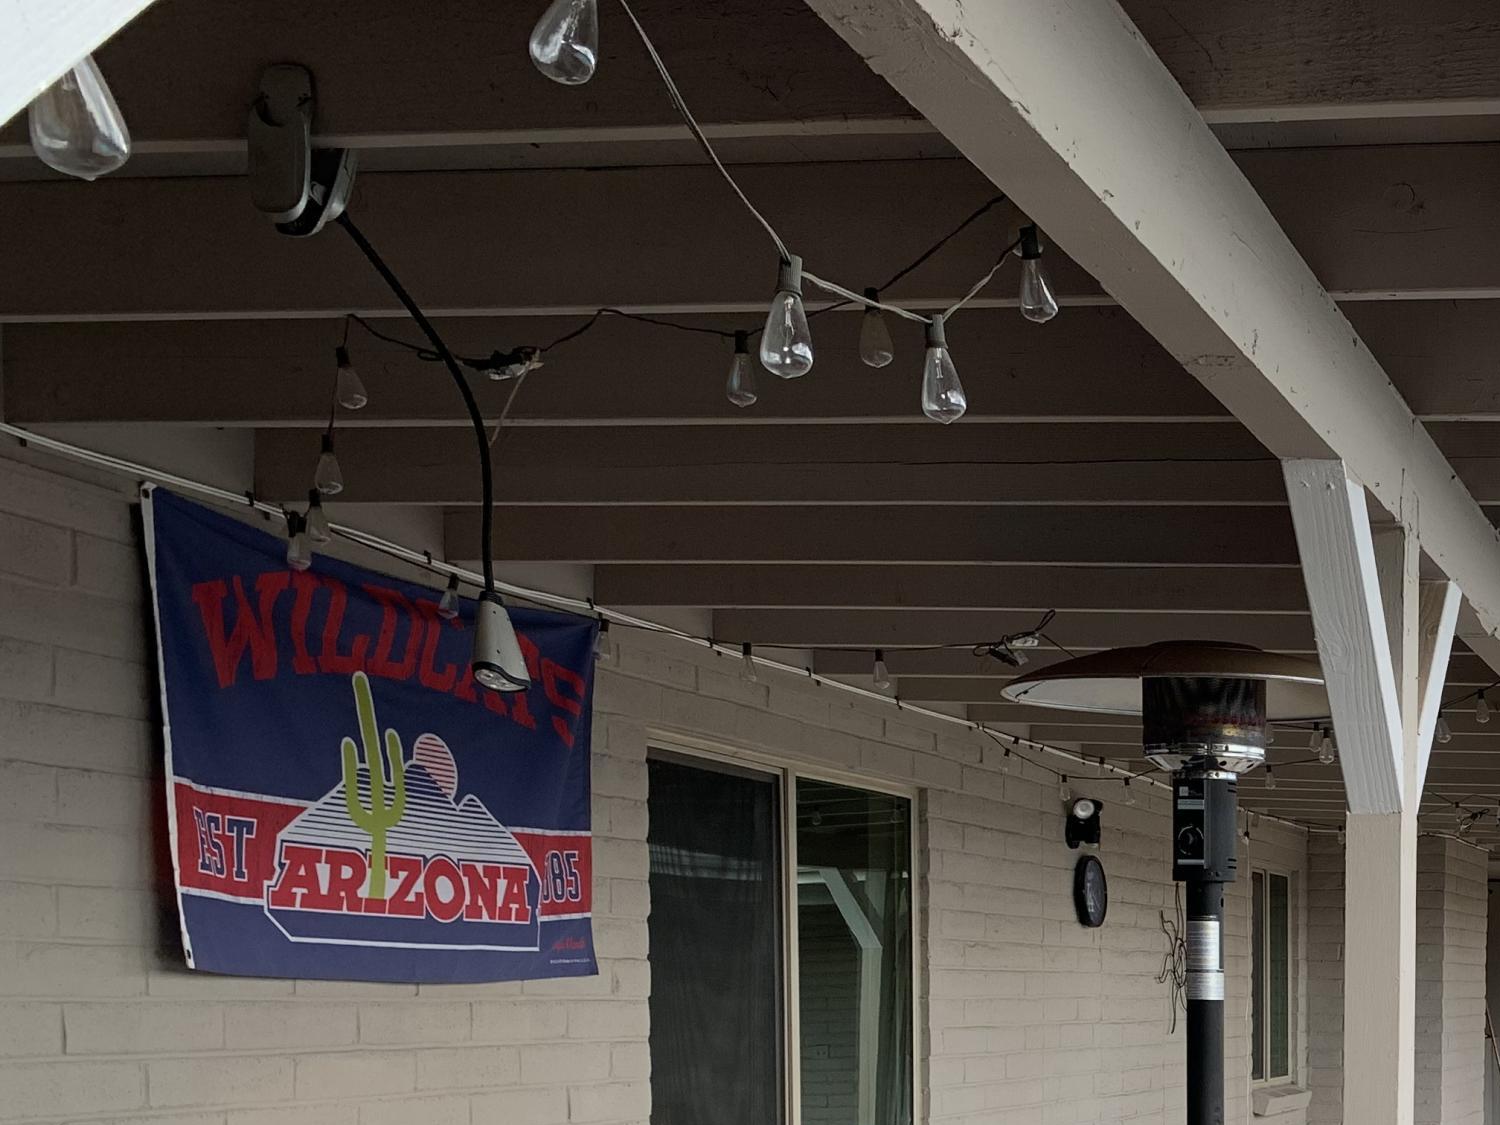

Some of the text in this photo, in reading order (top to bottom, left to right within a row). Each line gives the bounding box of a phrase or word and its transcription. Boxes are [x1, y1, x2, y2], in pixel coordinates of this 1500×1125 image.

[192, 570, 585, 747] WILDCTS
[193, 806, 257, 882] EST
[268, 842, 531, 925] ARIZONA
